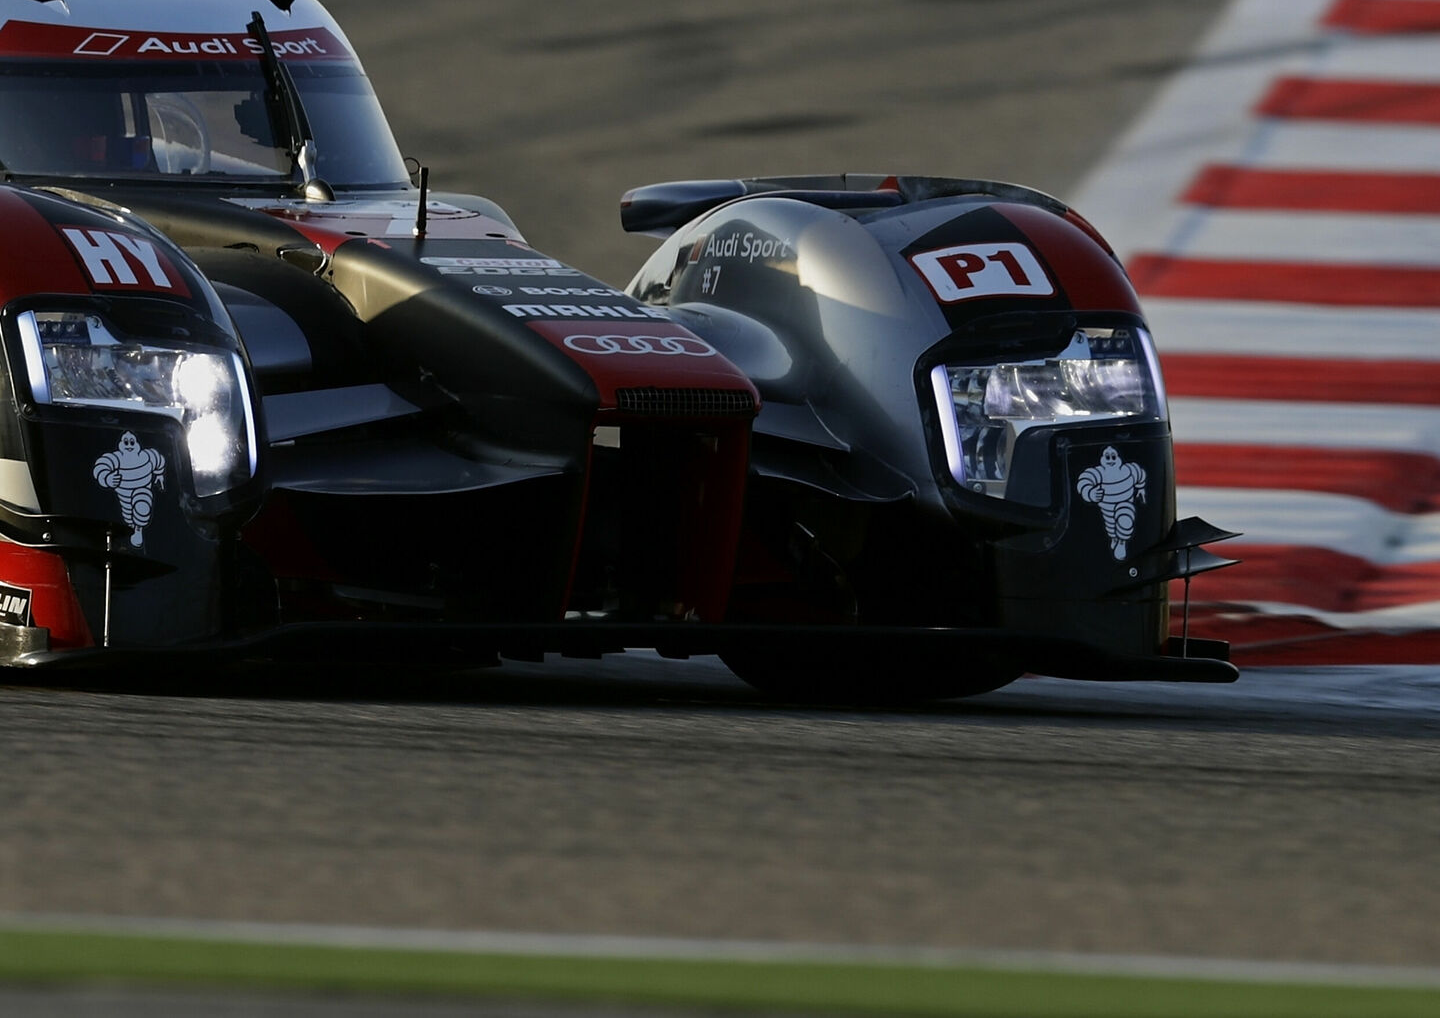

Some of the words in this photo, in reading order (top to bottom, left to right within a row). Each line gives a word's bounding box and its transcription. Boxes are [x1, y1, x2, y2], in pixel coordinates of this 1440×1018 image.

[136, 37, 237, 55] Audi
[249, 37, 327, 59] Sport
[62, 228, 172, 288] HY
[705, 233, 740, 257] Audi
[740, 232, 792, 264] Sport
[437, 266, 583, 277] EDGE
[456, 258, 550, 268] Castrol
[936, 251, 1032, 290] P1
[702, 265, 721, 295] #7
[502, 304, 670, 320] MAHLE
